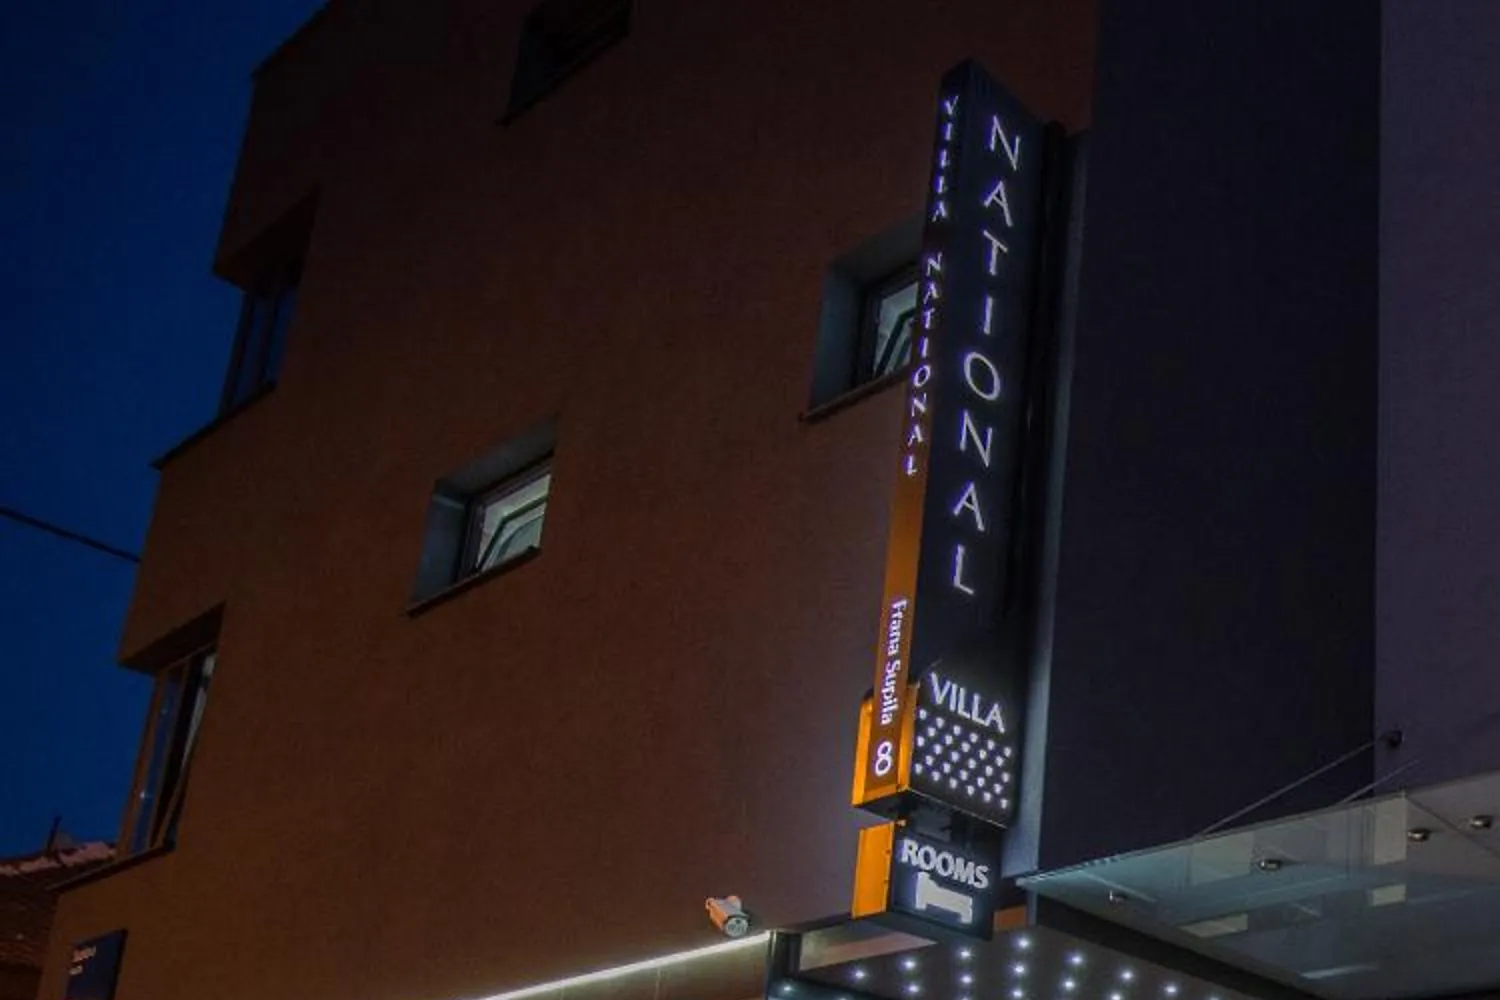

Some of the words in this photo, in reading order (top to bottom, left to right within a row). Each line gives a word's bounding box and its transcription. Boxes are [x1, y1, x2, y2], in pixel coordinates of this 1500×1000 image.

[931, 95, 959, 222] VILLA
[906, 252, 943, 476] NATIONAL
[952, 114, 1021, 597] NATIONAL
[928, 671, 1006, 734] VILLA
[874, 740, 893, 777] 8
[901, 837, 990, 890] ROOMS
